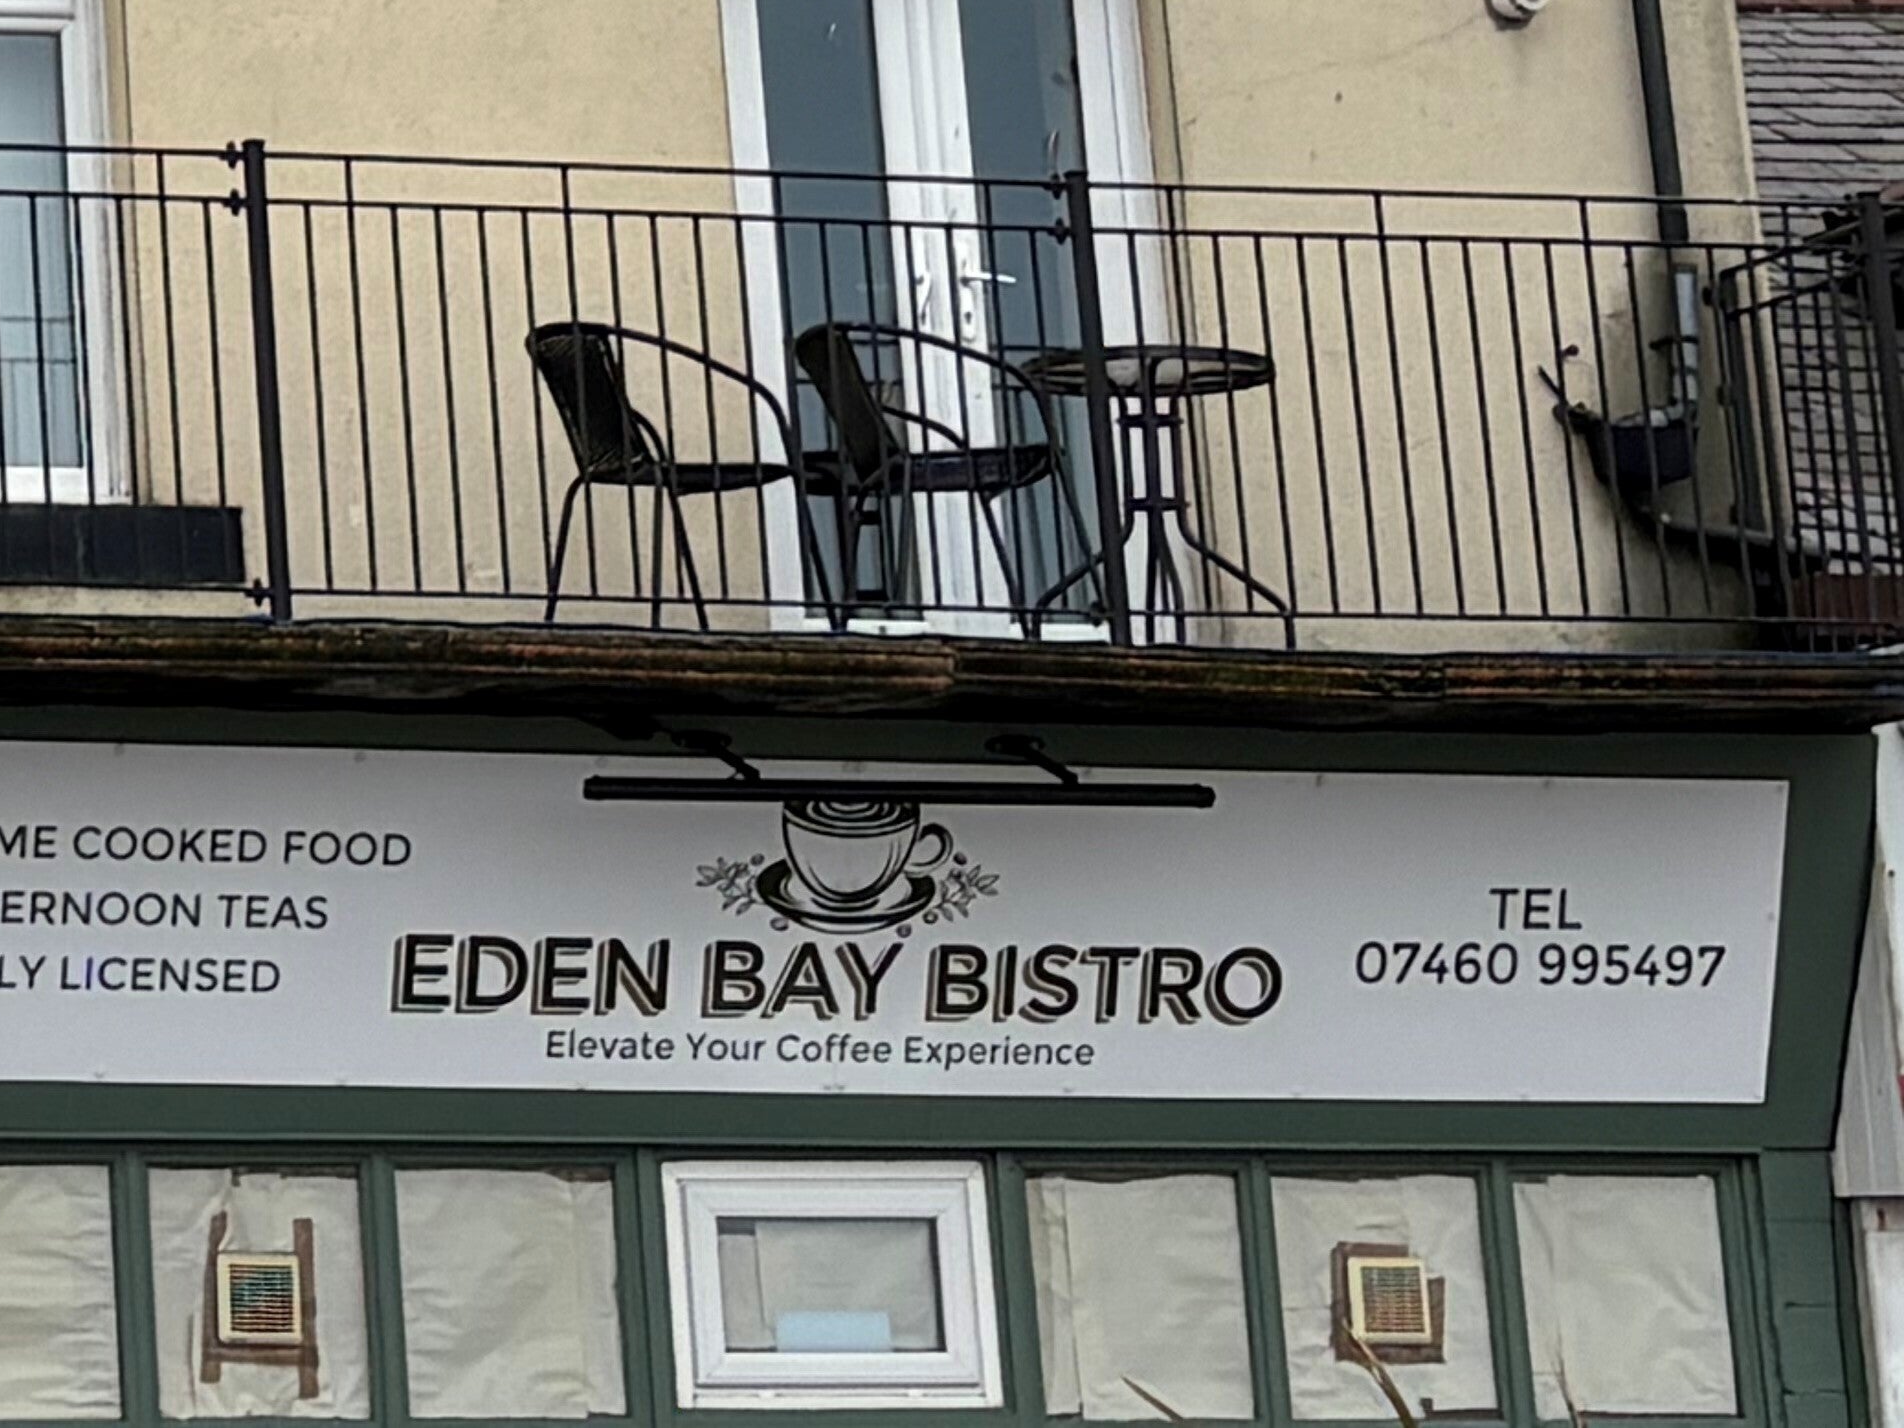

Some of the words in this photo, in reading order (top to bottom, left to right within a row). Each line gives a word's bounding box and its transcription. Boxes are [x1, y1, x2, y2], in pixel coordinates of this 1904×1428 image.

[73, 826, 267, 863] COOKED
[283, 831, 412, 866] FOOD
[218, 895, 328, 929] TEAS
[1489, 888, 1583, 931] TEL
[60, 957, 281, 993] LICENSED
[390, 933, 670, 1017] EDEN
[701, 940, 904, 1021] BAY
[925, 944, 1284, 1026] BISTRO
[1355, 941, 1518, 985] 07460
[1538, 944, 1726, 987] 995497
[546, 1030, 674, 1061] Elevate
[685, 1033, 766, 1063] Your
[776, 1034, 892, 1065] Coffee
[904, 1036, 1096, 1070] Experience
